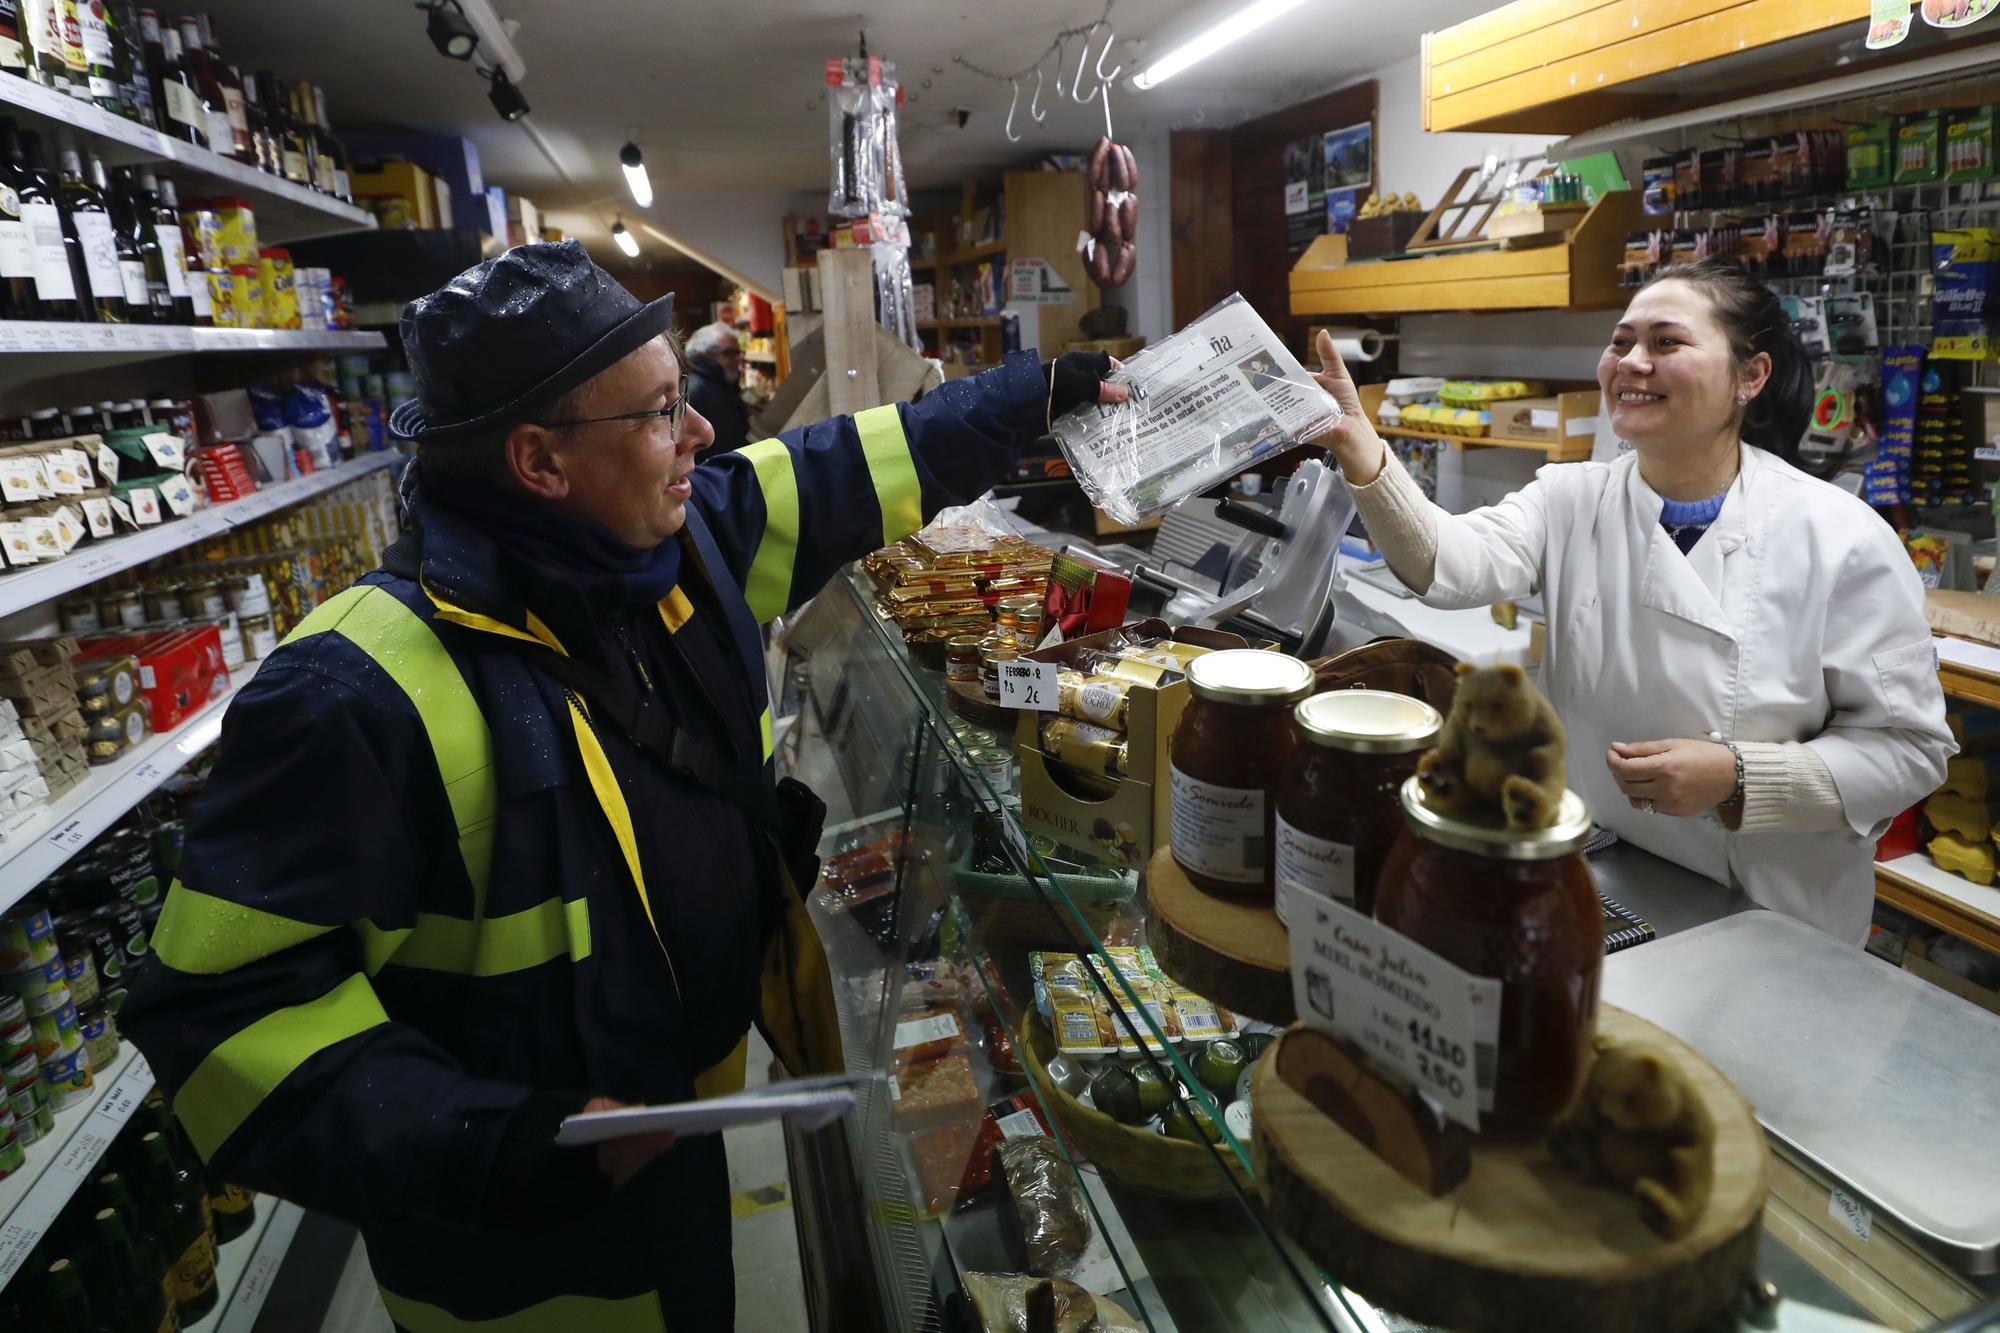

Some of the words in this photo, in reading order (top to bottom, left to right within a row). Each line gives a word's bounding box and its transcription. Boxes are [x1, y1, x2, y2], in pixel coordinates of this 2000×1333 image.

[1935, 288, 1986, 302] Gillette
[1137, 425, 1160, 441] menos
[1159, 420, 1169, 430] de
[1169, 415, 1177, 425] la
[1176, 404, 1197, 422] mitad
[1196, 399, 1206, 409] de
[1205, 394, 1213, 404] lo
[1149, 411, 1165, 425] final
[1164, 406, 1174, 416] de
[1174, 399, 1182, 410] la
[1180, 384, 1210, 406] Variante
[1081, 694, 1112, 711] ROCHER
[1190, 786, 1254, 811] Somiedo
[1029, 805, 1080, 835] ROCHER
[1284, 828, 1343, 866] Somiedo
